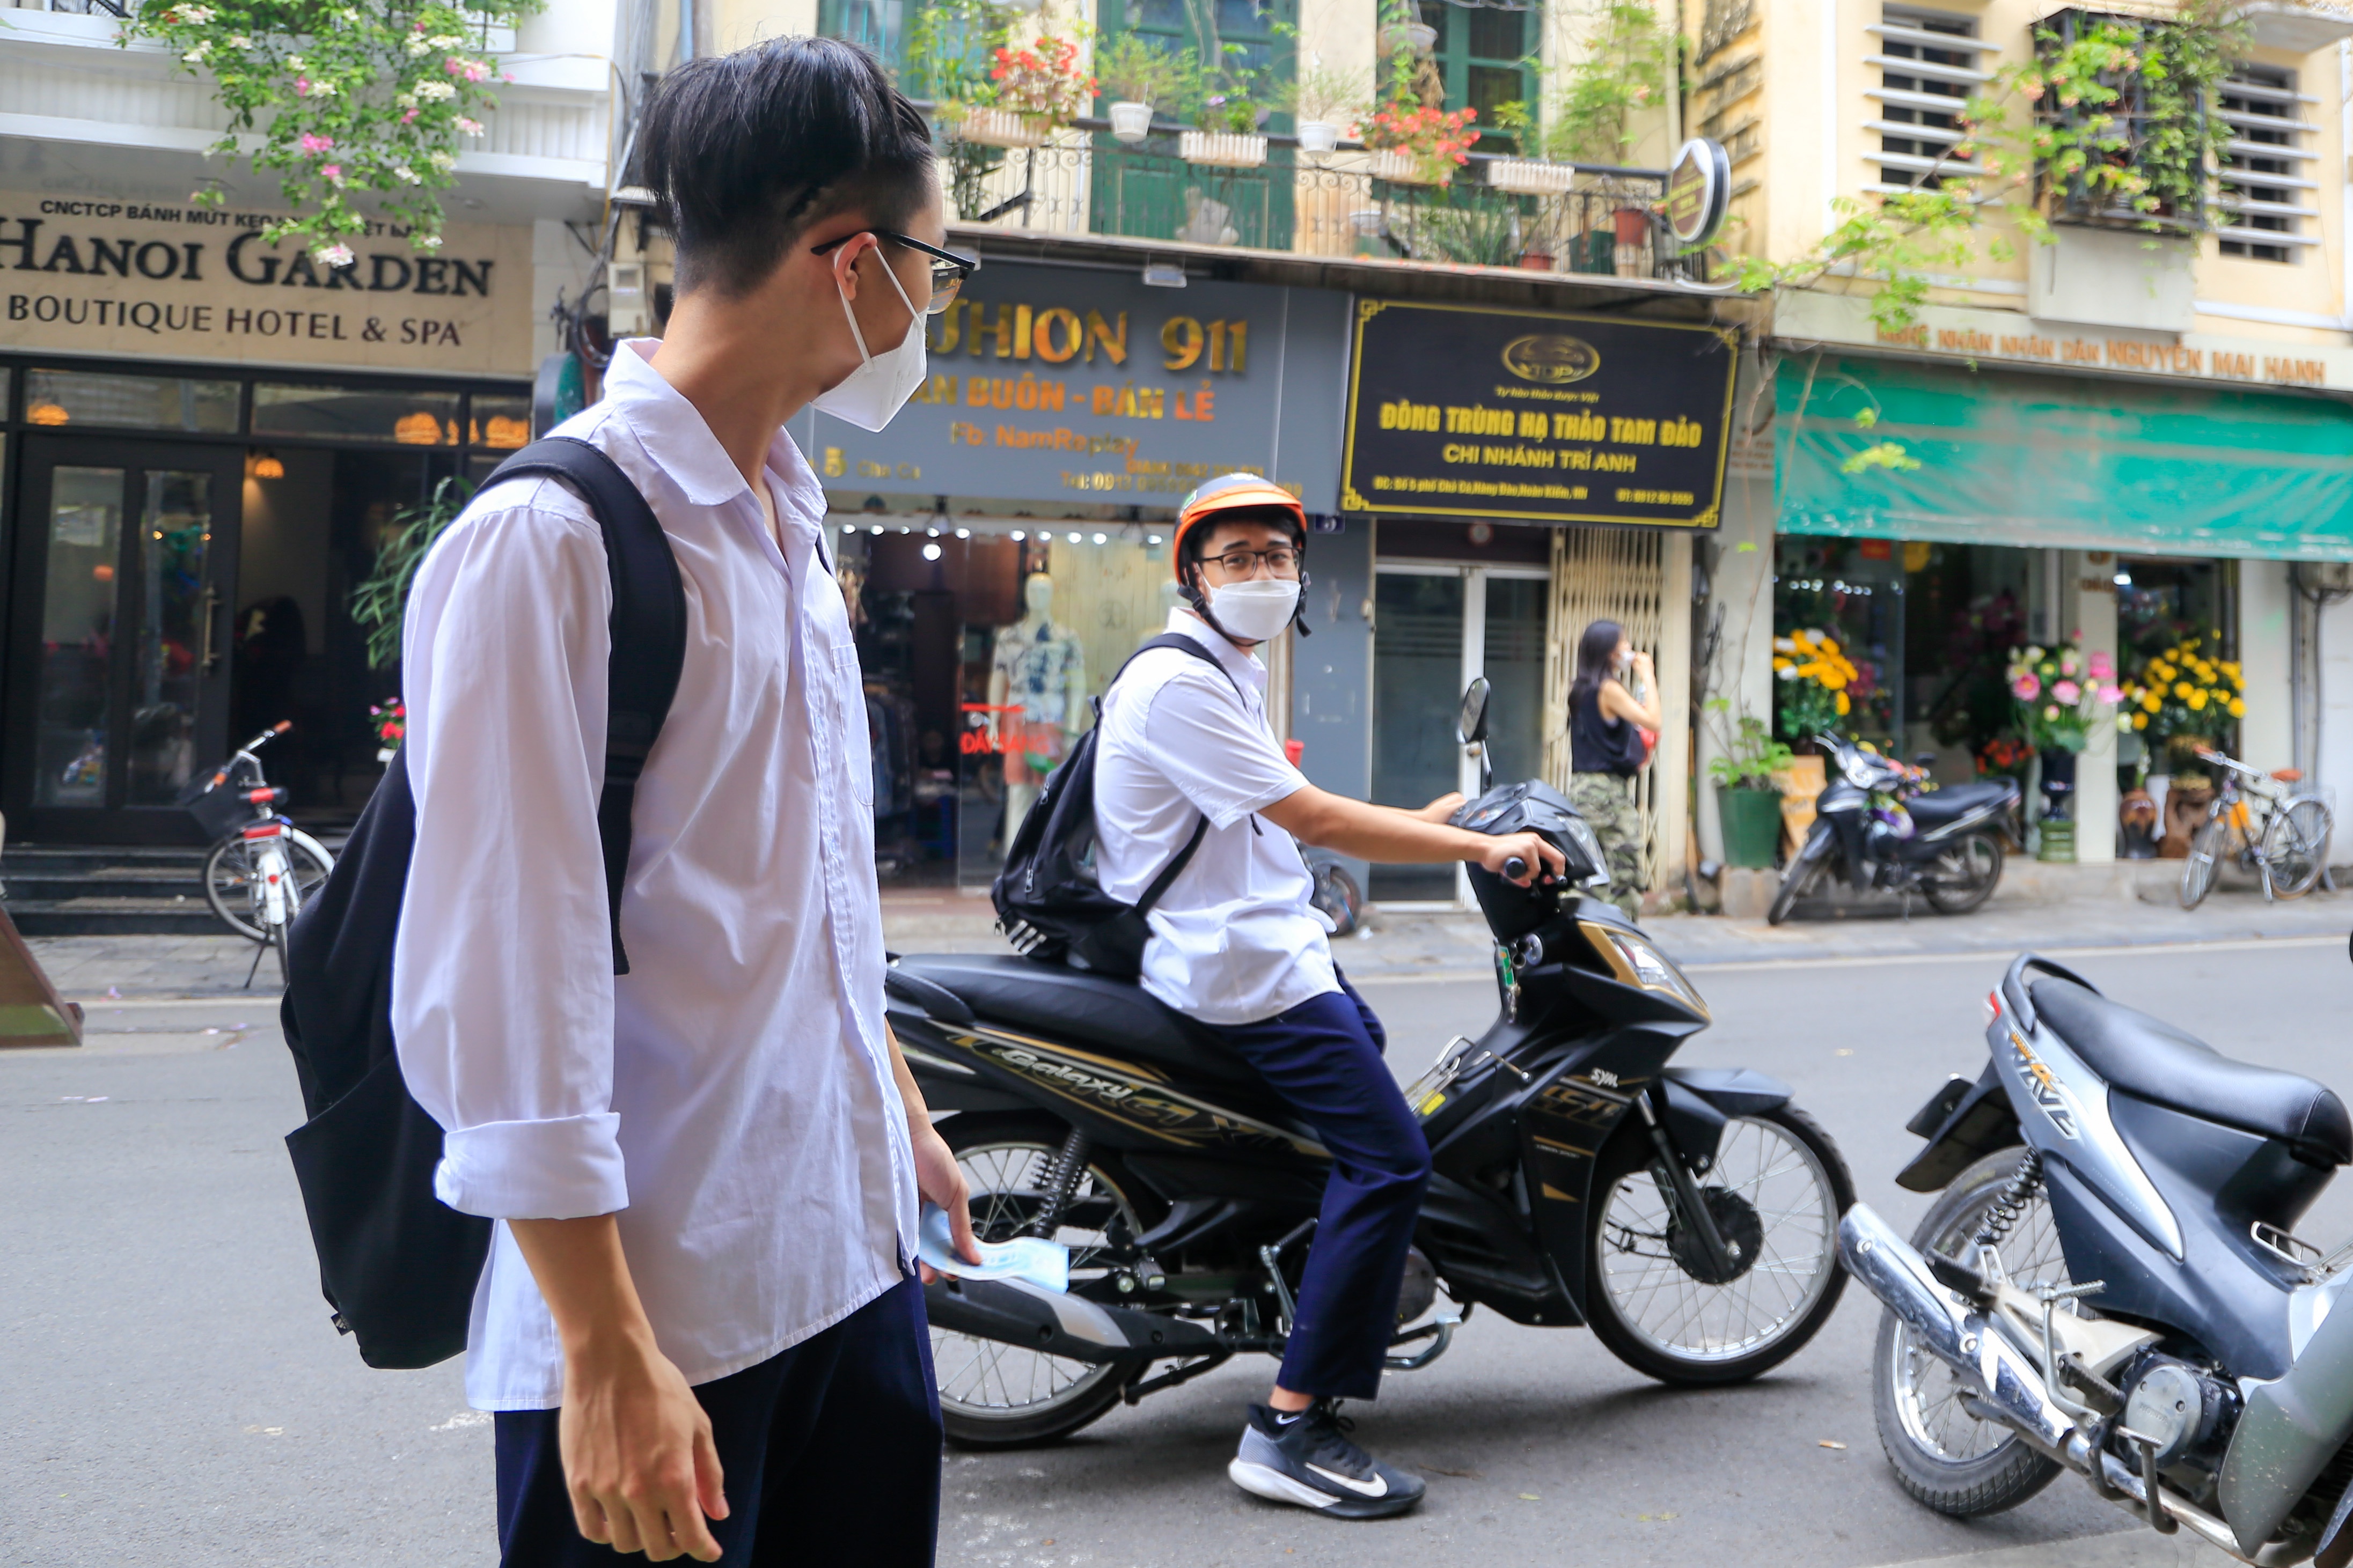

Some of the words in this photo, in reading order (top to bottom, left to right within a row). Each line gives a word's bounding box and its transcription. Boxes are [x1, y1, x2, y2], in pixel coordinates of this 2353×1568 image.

[41, 200, 122, 216] CNCTCP
[127, 202, 181, 222] BÁNH
[225, 231, 493, 297] GARDEN
[9, 295, 212, 334] BOUTIQUE
[226, 308, 348, 340] HOTEL
[361, 316, 387, 342] &
[400, 318, 461, 347] SPA
[927, 298, 1127, 365] SHION
[1161, 315, 1248, 372] 911
[1938, 328, 1993, 352] NHÂN
[2000, 334, 2056, 358] NHÂN
[2062, 337, 2101, 362] DÂN
[2106, 336, 2204, 372] NGUYỄN
[2212, 350, 2256, 378] MAI
[967, 371, 1066, 413] BUÔN
[1091, 379, 1165, 420] BÁN
[1174, 378, 1215, 422] LẺ
[996, 424, 1140, 461] NamReplay
[1445, 403, 1515, 437] TRÙNG
[1518, 410, 1549, 444] HẠ
[1552, 408, 1607, 443] THẢO
[1610, 416, 1657, 446] TAM
[1659, 414, 1703, 448] ĐẢO
[1442, 442, 1480, 465] CHI
[1482, 443, 1556, 468] NHÁNH
[1558, 447, 1593, 470] TRÍ
[1592, 452, 1637, 474] ANH
[1000, 1048, 1133, 1100] Galaxy
[1589, 1067, 1619, 1088] SYM
